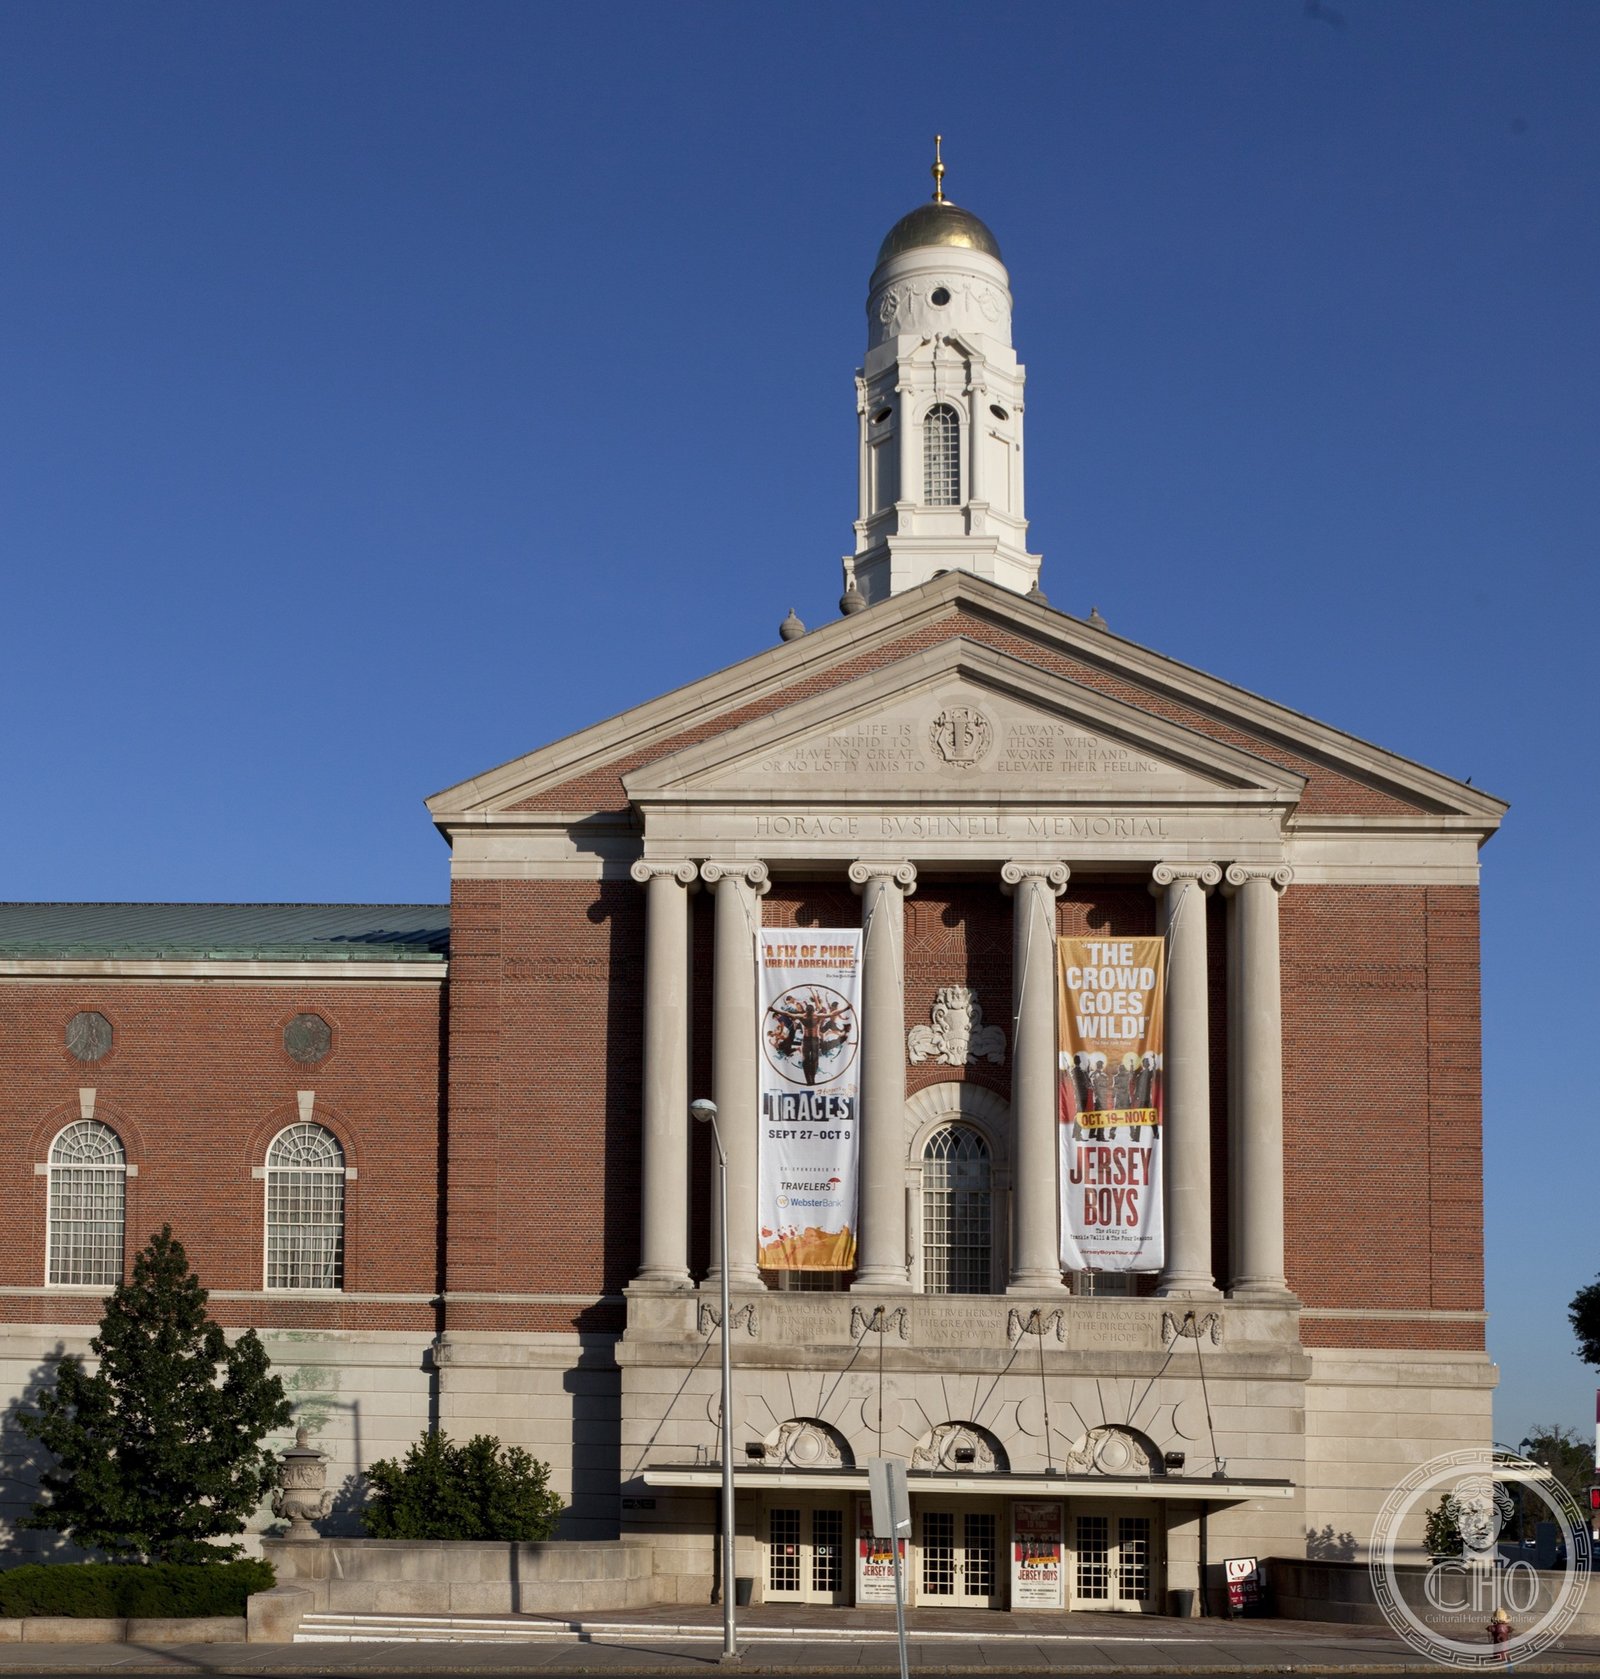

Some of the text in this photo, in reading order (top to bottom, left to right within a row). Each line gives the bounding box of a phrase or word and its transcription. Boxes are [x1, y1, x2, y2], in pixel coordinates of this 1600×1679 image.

[857, 724, 912, 735] LIFE IS
[1008, 725, 1065, 736] ALWAYS
[827, 737, 911, 748] INSIPID TO
[1008, 738, 1098, 748] THOSE WHO
[795, 750, 914, 760] HAVE NO GREAT
[1006, 750, 1128, 760] WORKS IN HAND
[762, 761, 925, 772] OR NO LOFTY AIMS TO
[998, 762, 1158, 772] ELEVATE THEIR FEELING
[755, 816, 1170, 836] HORACE BVSHNELL MEMORIAL
[777, 945, 797, 958] FIX
[800, 945, 817, 958] OF
[820, 946, 854, 958] PURE
[765, 959, 796, 968] URBAN
[1066, 967, 1155, 990] CROWD
[1080, 991, 1142, 1014] GOES
[768, 1089, 850, 1120] TRACES
[1082, 1114, 1104, 1126] OCT.
[1149, 1110, 1155, 1122] 6
[768, 1130, 796, 1139] SEPT
[844, 1130, 850, 1139] 9
[1070, 1146, 1152, 1185] JERSEY
[780, 1182, 831, 1191] TRAVELERS
[1084, 1188, 1138, 1226] BOYS
[785, 1305, 811, 1314] WHO
[813, 1306, 832, 1314] HAS
[966, 1309, 993, 1317] HERO
[1073, 1311, 1108, 1319] POWER
[940, 1320, 974, 1328] GREAT
[976, 1320, 1002, 1328] WISE
[1100, 1322, 1153, 1330] DIRECTION
[925, 1330, 949, 1338] MAN
[951, 1330, 964, 1338] OF
[863, 1566, 902, 1576] JERSEY BOS
[1018, 1570, 1058, 1581] JERSEY BOYS
[1230, 1581, 1256, 1592] valet
